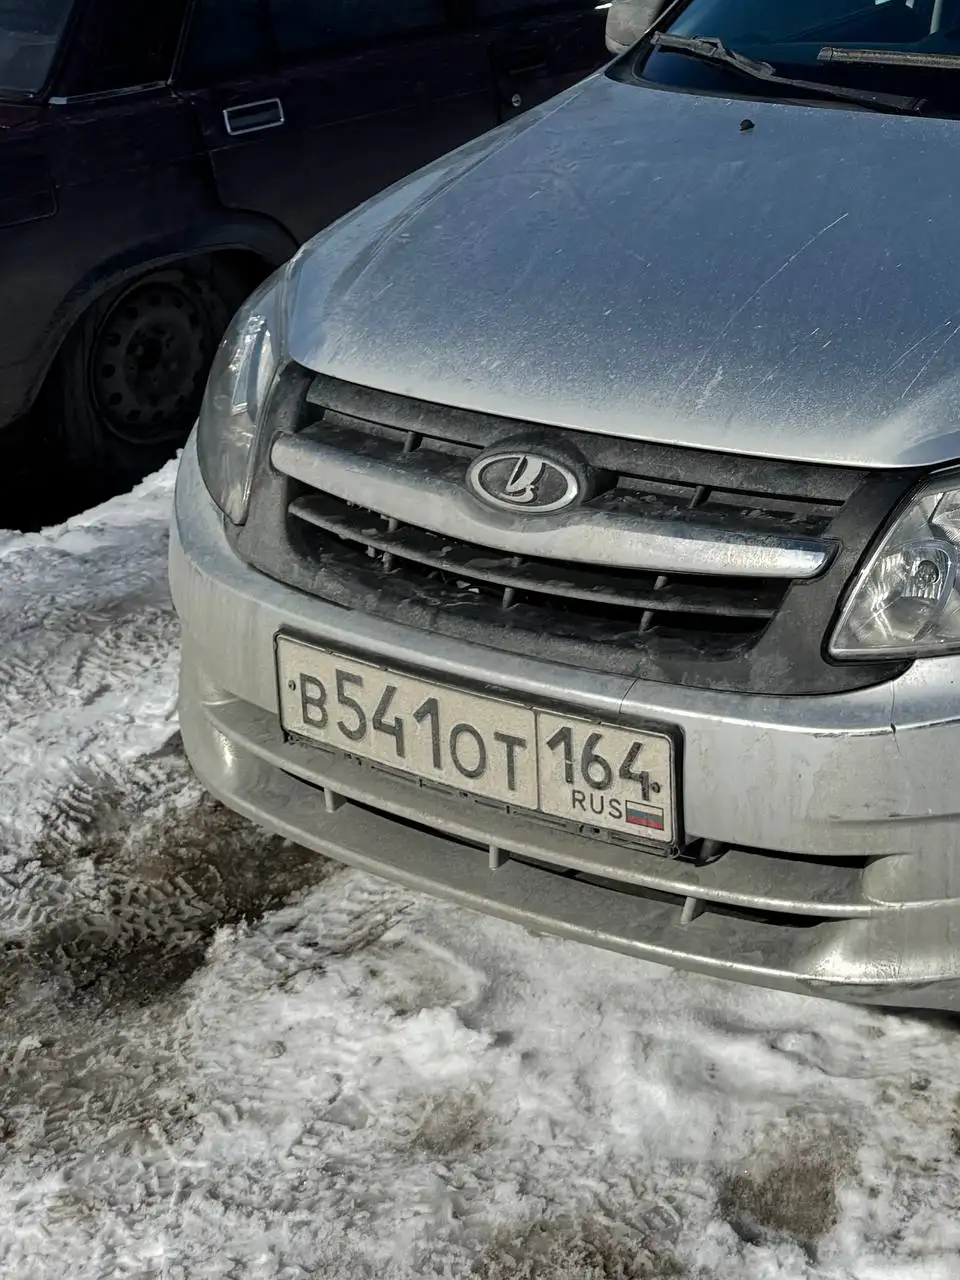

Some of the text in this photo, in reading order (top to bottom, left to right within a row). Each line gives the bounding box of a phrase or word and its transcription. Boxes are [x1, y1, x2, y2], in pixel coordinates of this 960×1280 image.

[299, 668, 651, 801] В541ОТ 164
[571, 788, 623, 820] RUS
